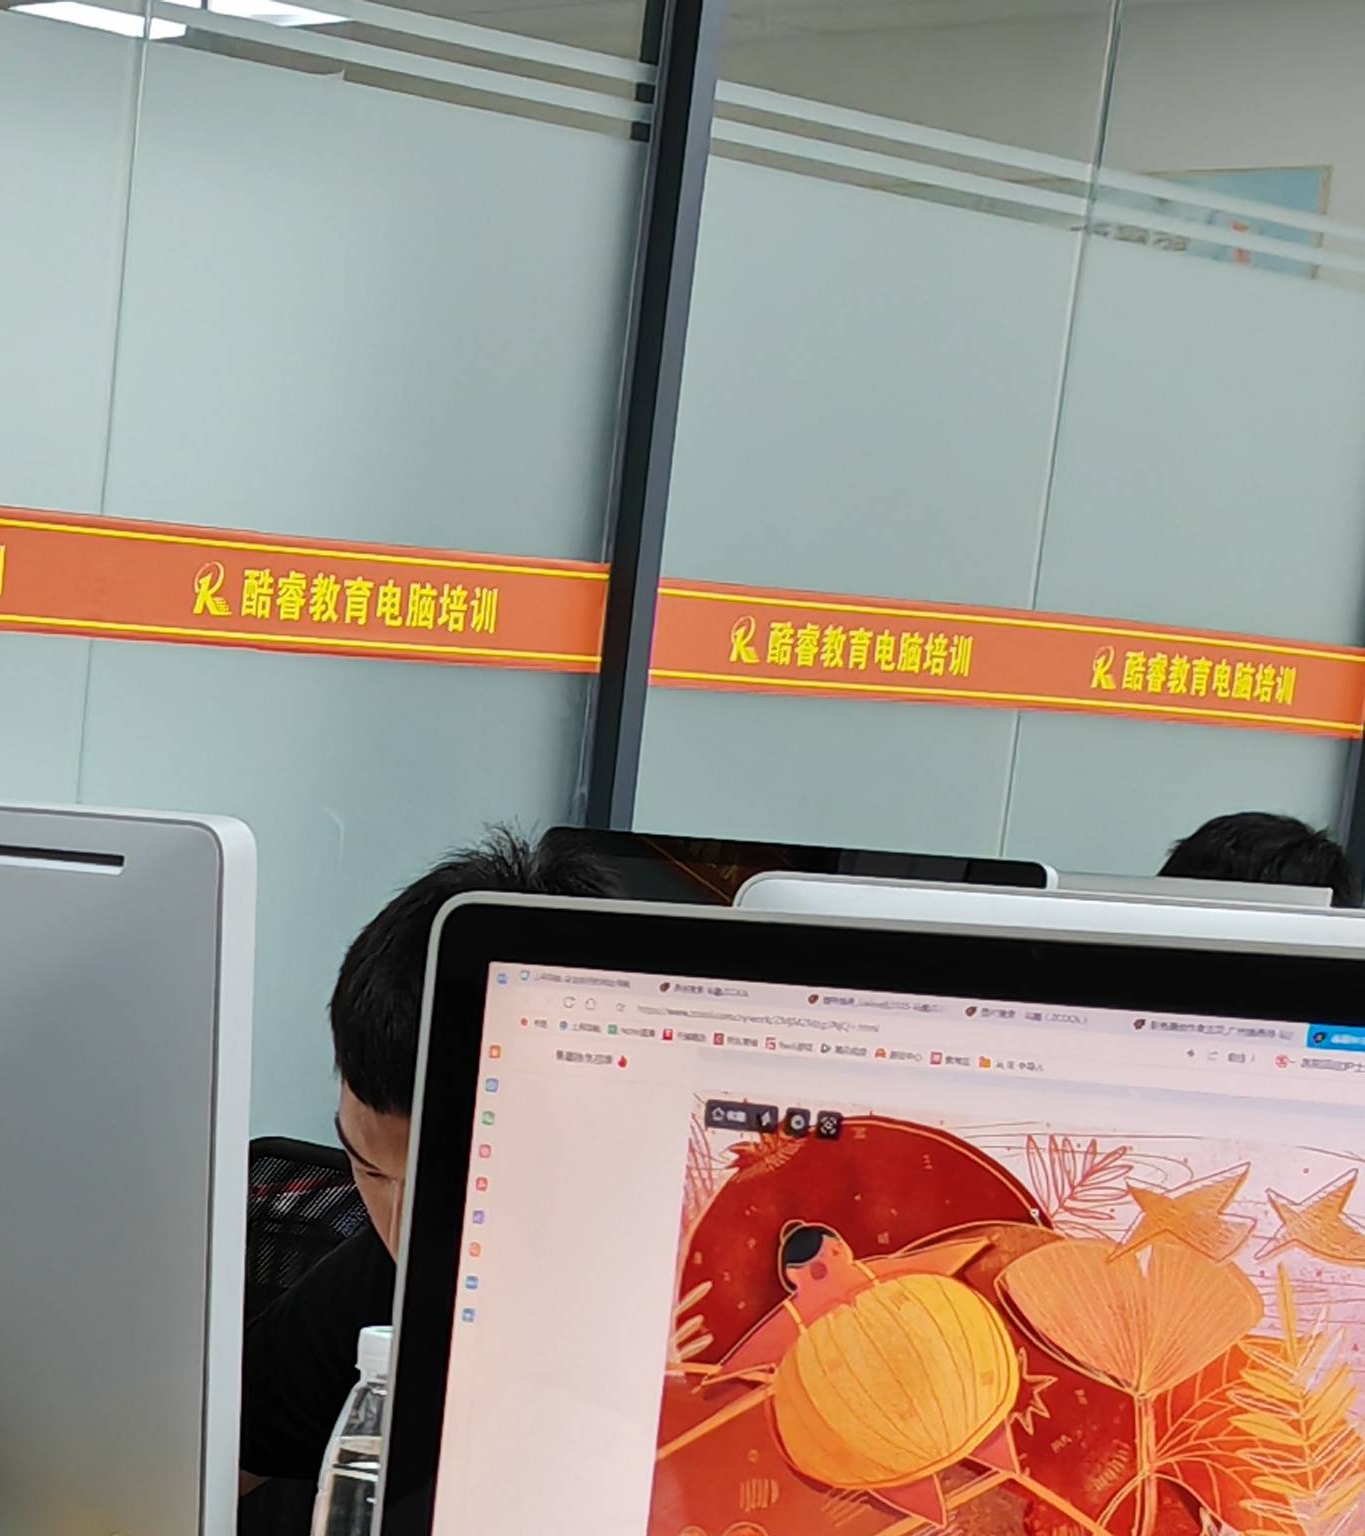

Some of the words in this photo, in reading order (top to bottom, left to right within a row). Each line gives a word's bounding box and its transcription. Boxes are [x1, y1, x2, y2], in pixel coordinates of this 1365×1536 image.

[240, 569, 499, 634] 酷睿教育电脑培训
[766, 621, 974, 677] 酷睿教育电脑培训
[1122, 651, 1297, 706] 酷睿教育电脑培训
